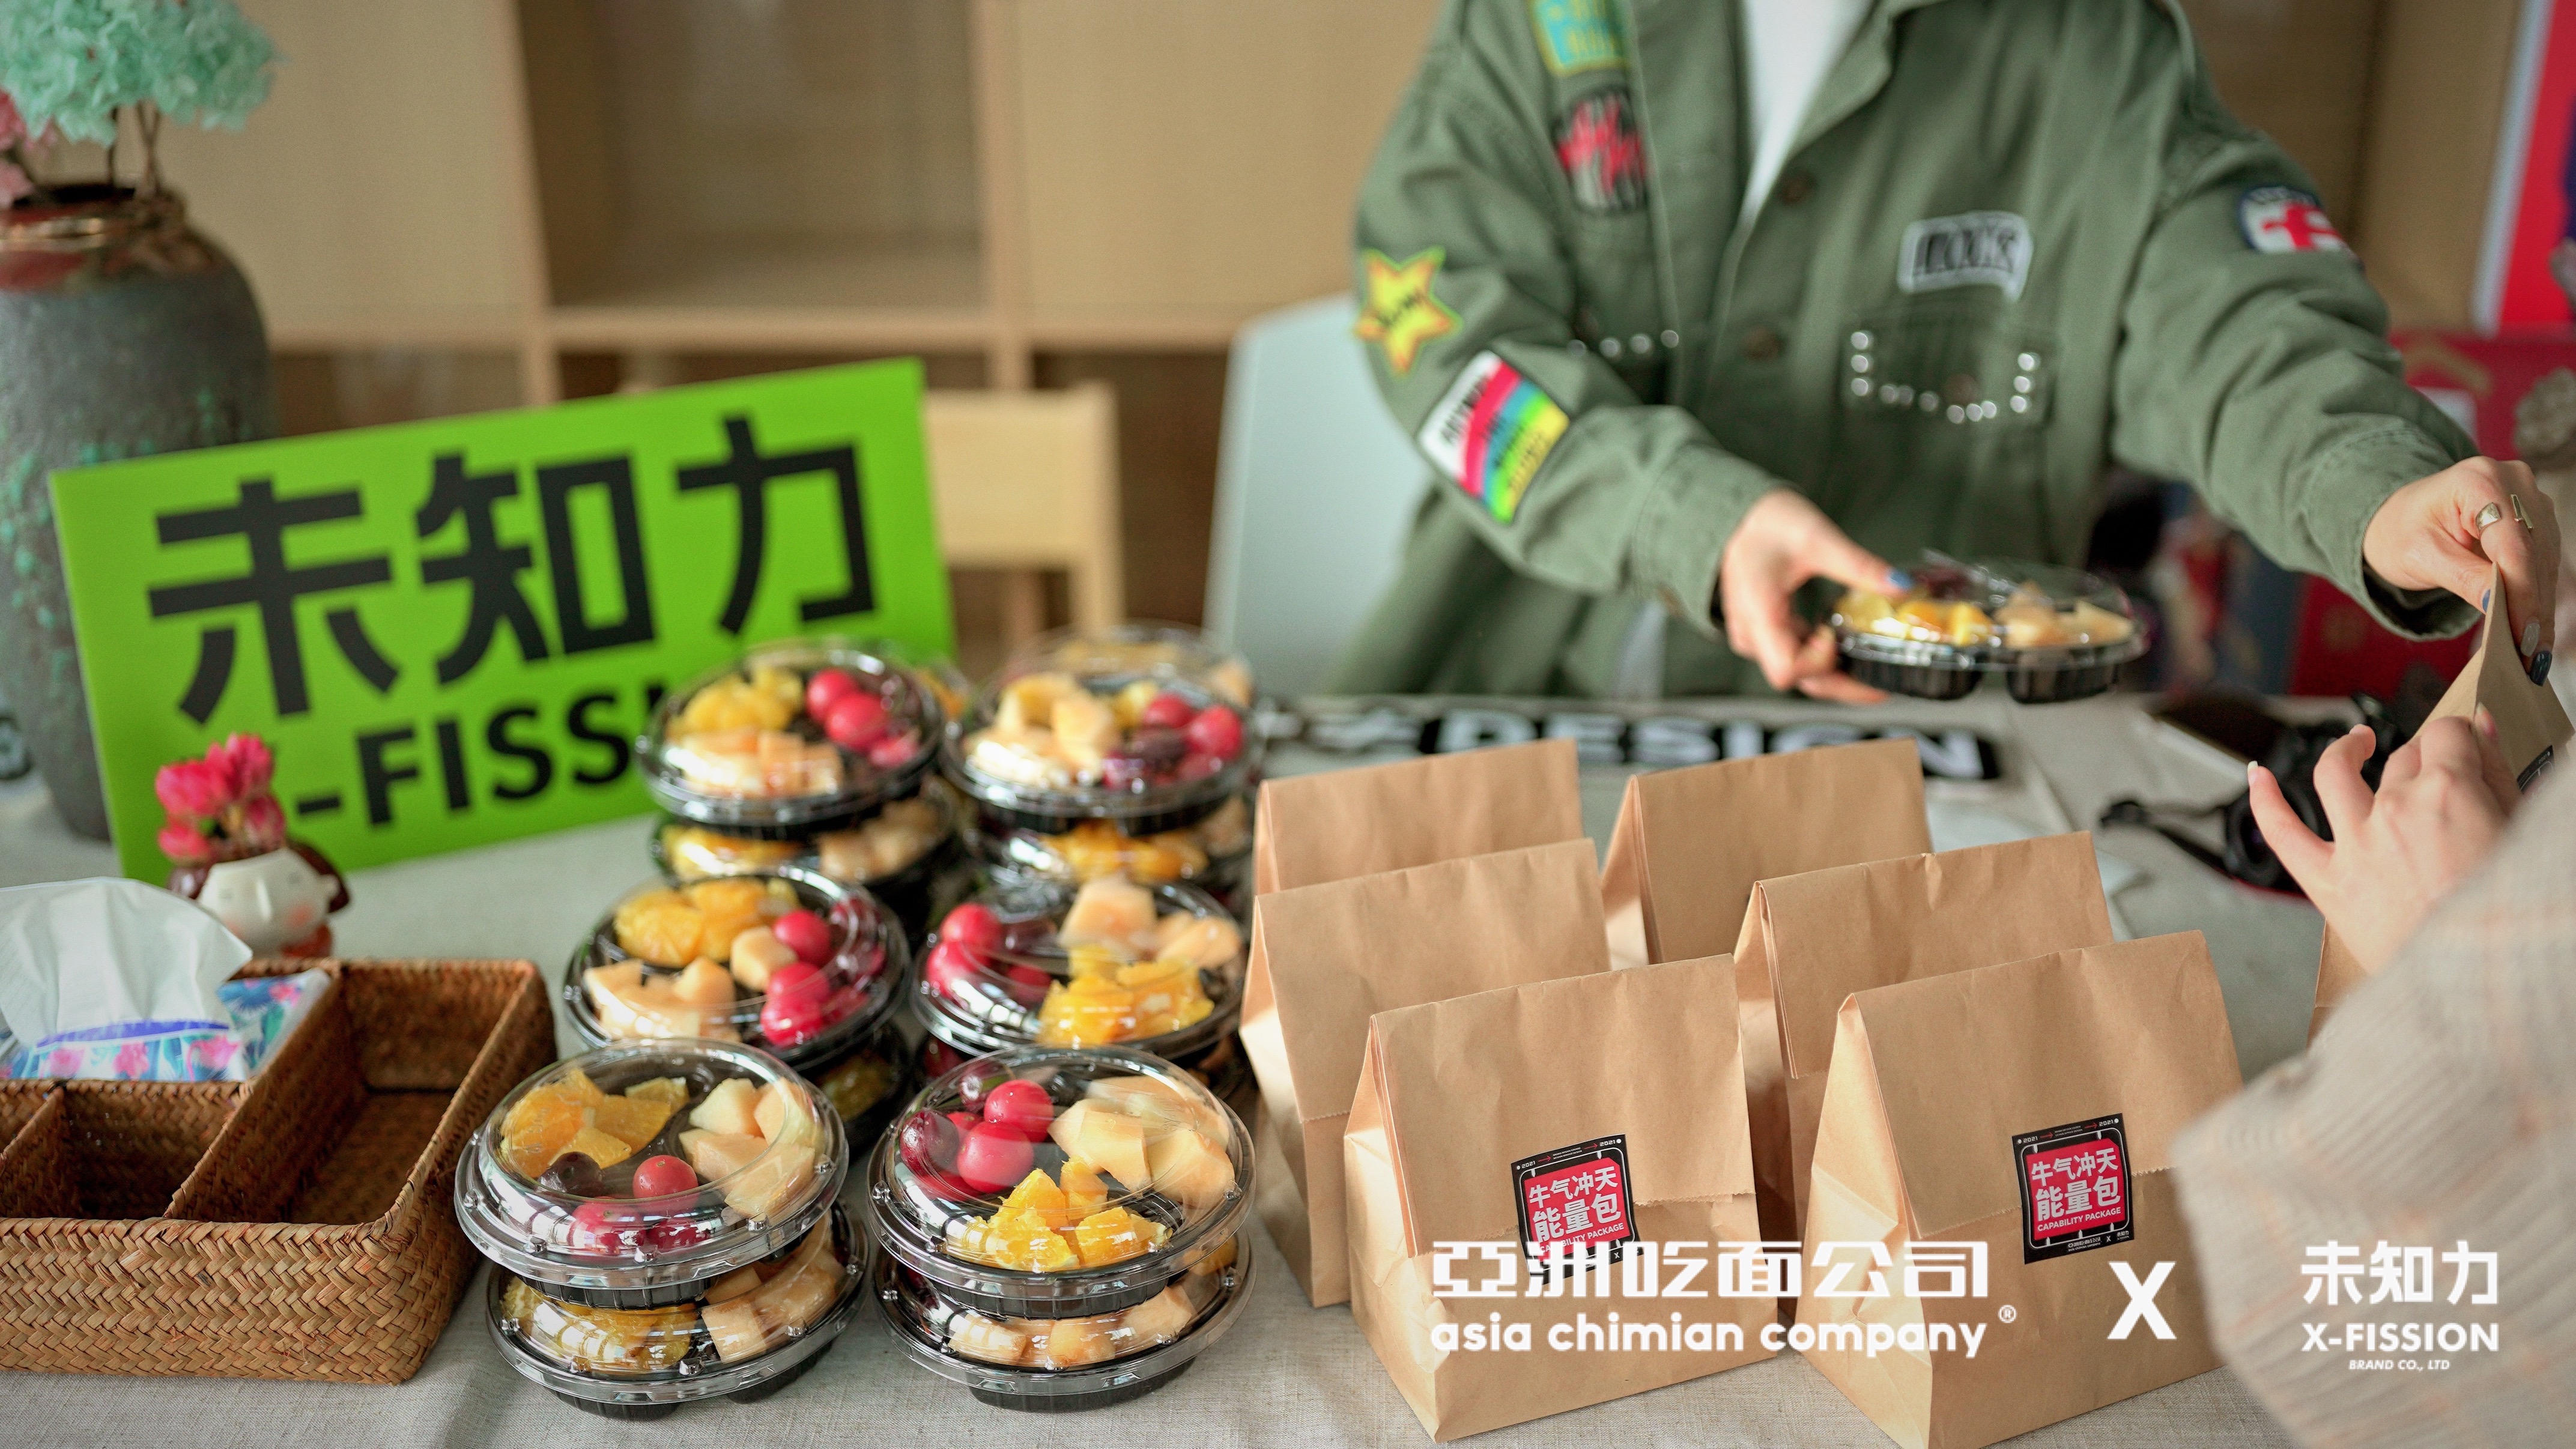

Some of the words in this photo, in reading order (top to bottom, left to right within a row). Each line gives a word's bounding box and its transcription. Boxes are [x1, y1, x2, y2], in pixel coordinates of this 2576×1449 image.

[148, 416, 876, 724] 未知力
[1521, 1160, 1536, 1169] 2021
[2031, 1147, 2118, 1187] 牛气冲天
[1529, 1166, 1618, 1209] 牛气冲天
[2035, 1176, 2121, 1221] 能量包
[1533, 1193, 1622, 1243] 能量包
[1540, 1233, 1586, 1253] CABILITY
[1587, 1223, 1625, 1239] PACKAGE
[2037, 1215, 2085, 1232] CAPABILITY
[2085, 1206, 2121, 1221] PACKAGE
